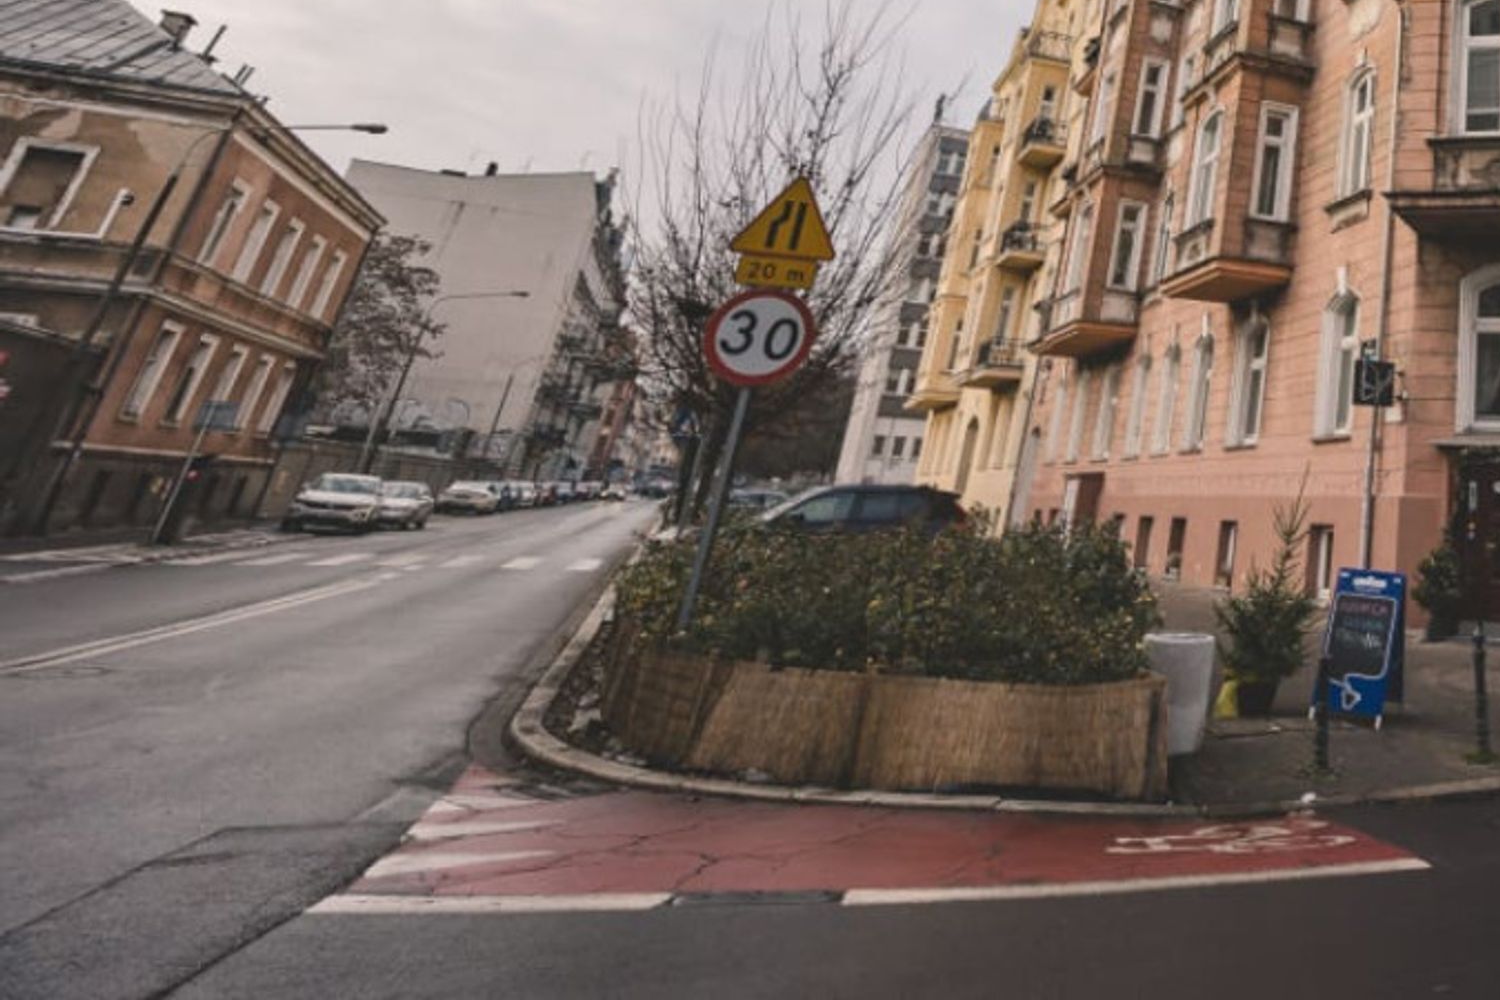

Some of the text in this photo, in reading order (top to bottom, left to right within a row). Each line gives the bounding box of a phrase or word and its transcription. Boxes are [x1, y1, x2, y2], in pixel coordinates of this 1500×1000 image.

[748, 263, 804, 282] 20 m
[719, 309, 799, 361] 30
